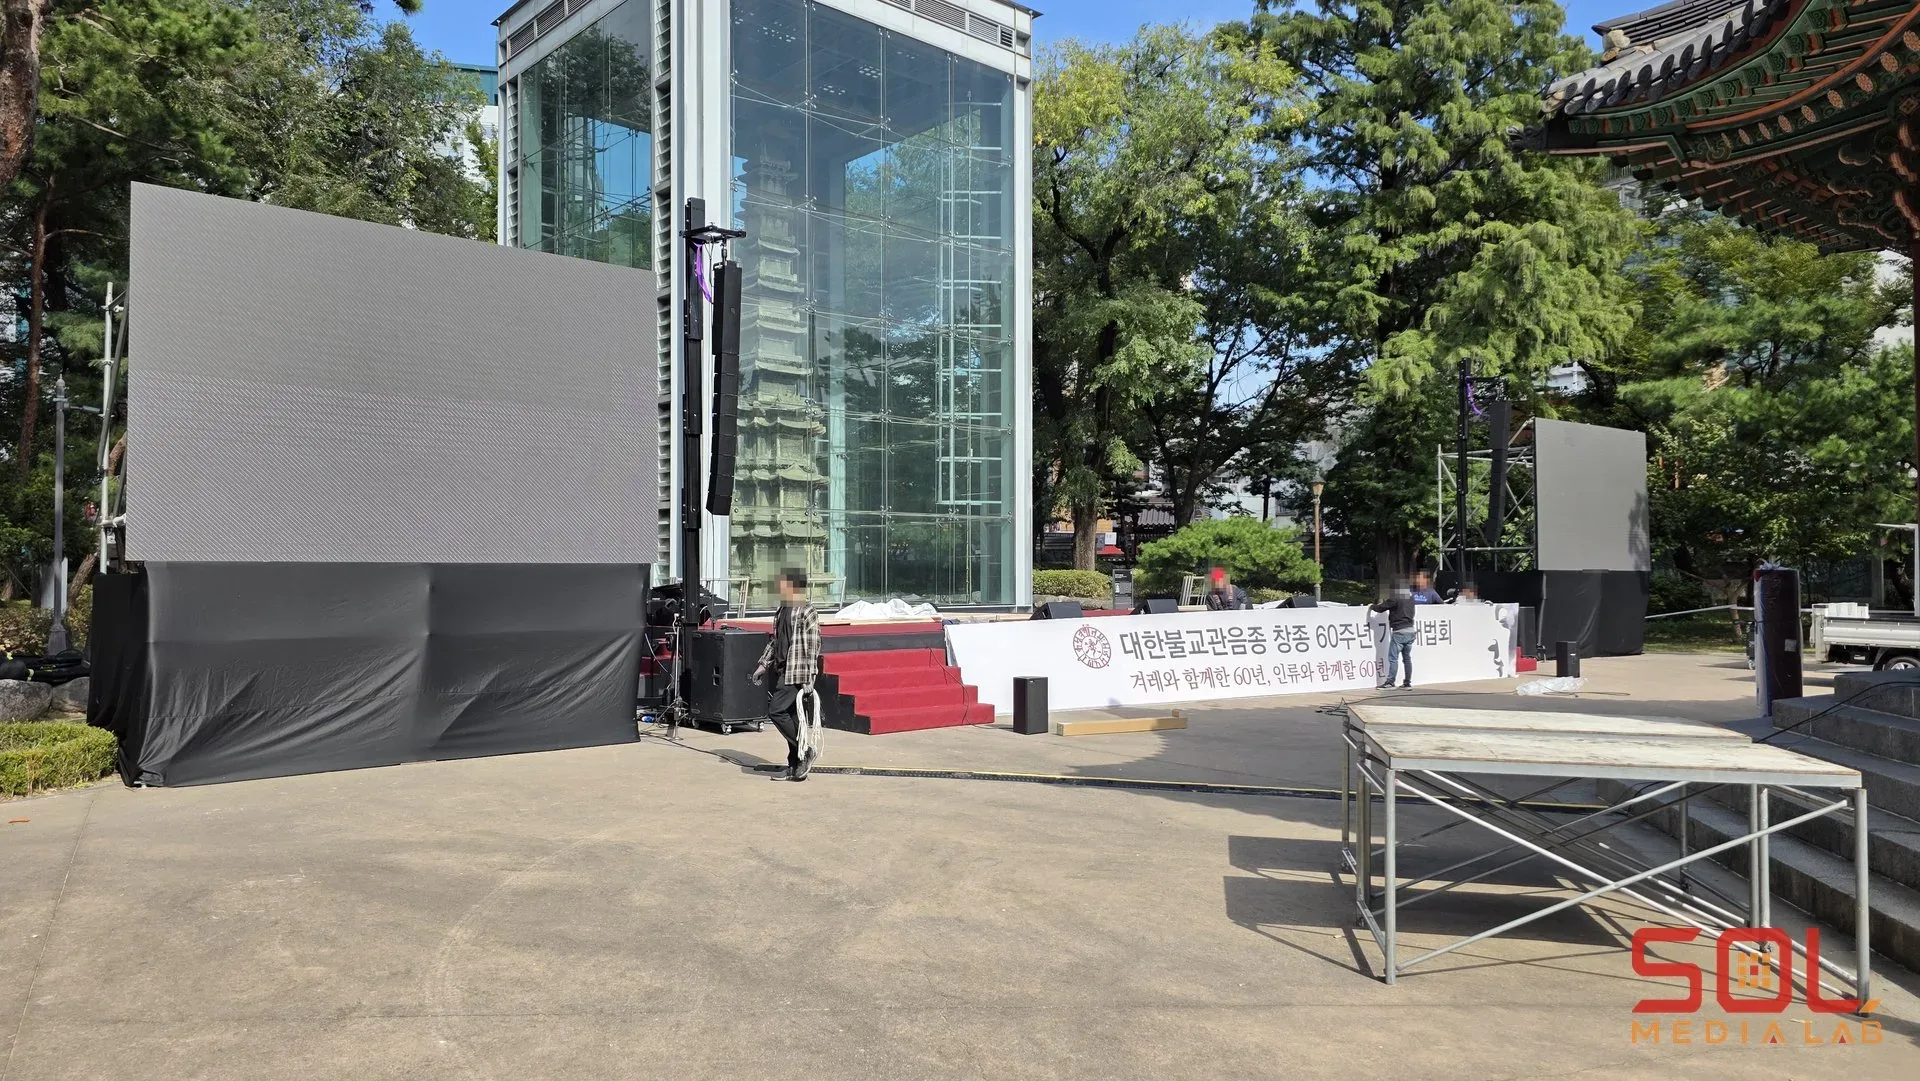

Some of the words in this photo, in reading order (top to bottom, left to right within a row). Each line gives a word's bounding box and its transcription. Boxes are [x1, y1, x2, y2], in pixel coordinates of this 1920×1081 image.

[1119, 626, 1267, 660] 대한불교관음종
[1273, 624, 1310, 654] 창종
[1316, 622, 1373, 650] 60주년
[1130, 669, 1180, 693] 겨레와
[1182, 666, 1230, 690] 함께한
[1233, 664, 1271, 687] 60년,
[1273, 662, 1314, 684] 인류와
[1316, 659, 1356, 681] 함께할
[1359, 658, 1386, 678] 60년
